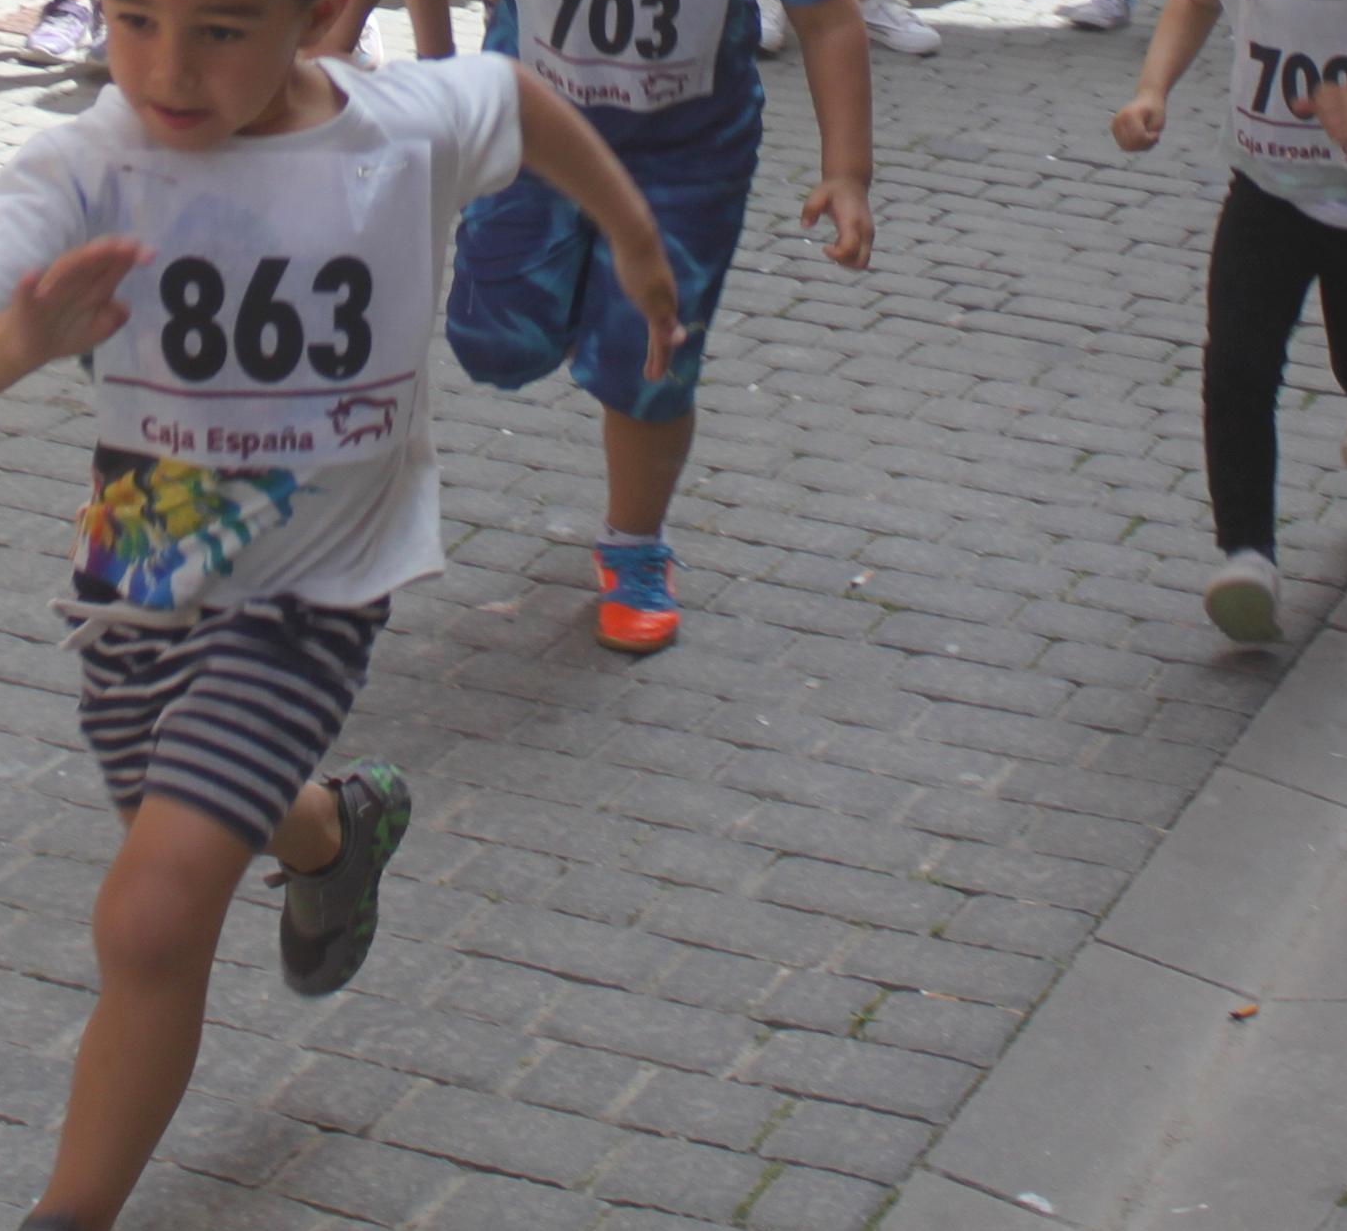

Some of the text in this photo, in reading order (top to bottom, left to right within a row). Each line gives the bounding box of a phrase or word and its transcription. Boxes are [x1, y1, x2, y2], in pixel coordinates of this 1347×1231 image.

[160, 255, 373, 382] 863
[141, 416, 315, 461] Caja España
